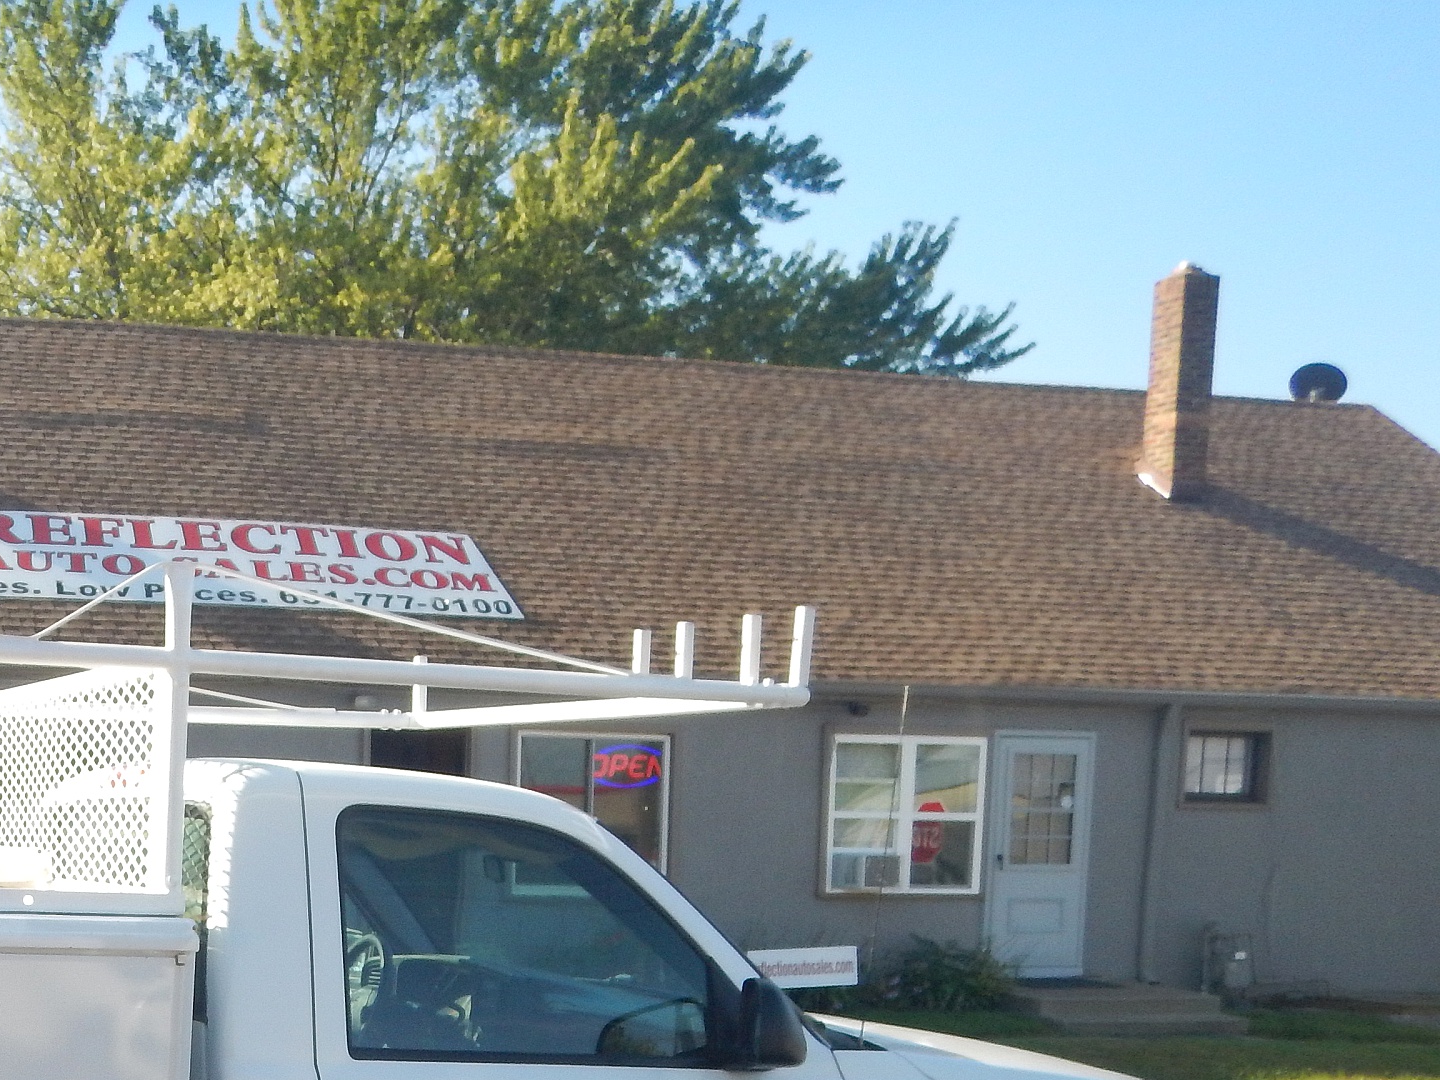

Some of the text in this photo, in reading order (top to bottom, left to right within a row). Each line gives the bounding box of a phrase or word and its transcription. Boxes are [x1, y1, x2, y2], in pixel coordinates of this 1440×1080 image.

[56, 580, 129, 598] Low
[144, 583, 268, 603] Pces.
[593, 753, 661, 778] OPEN
